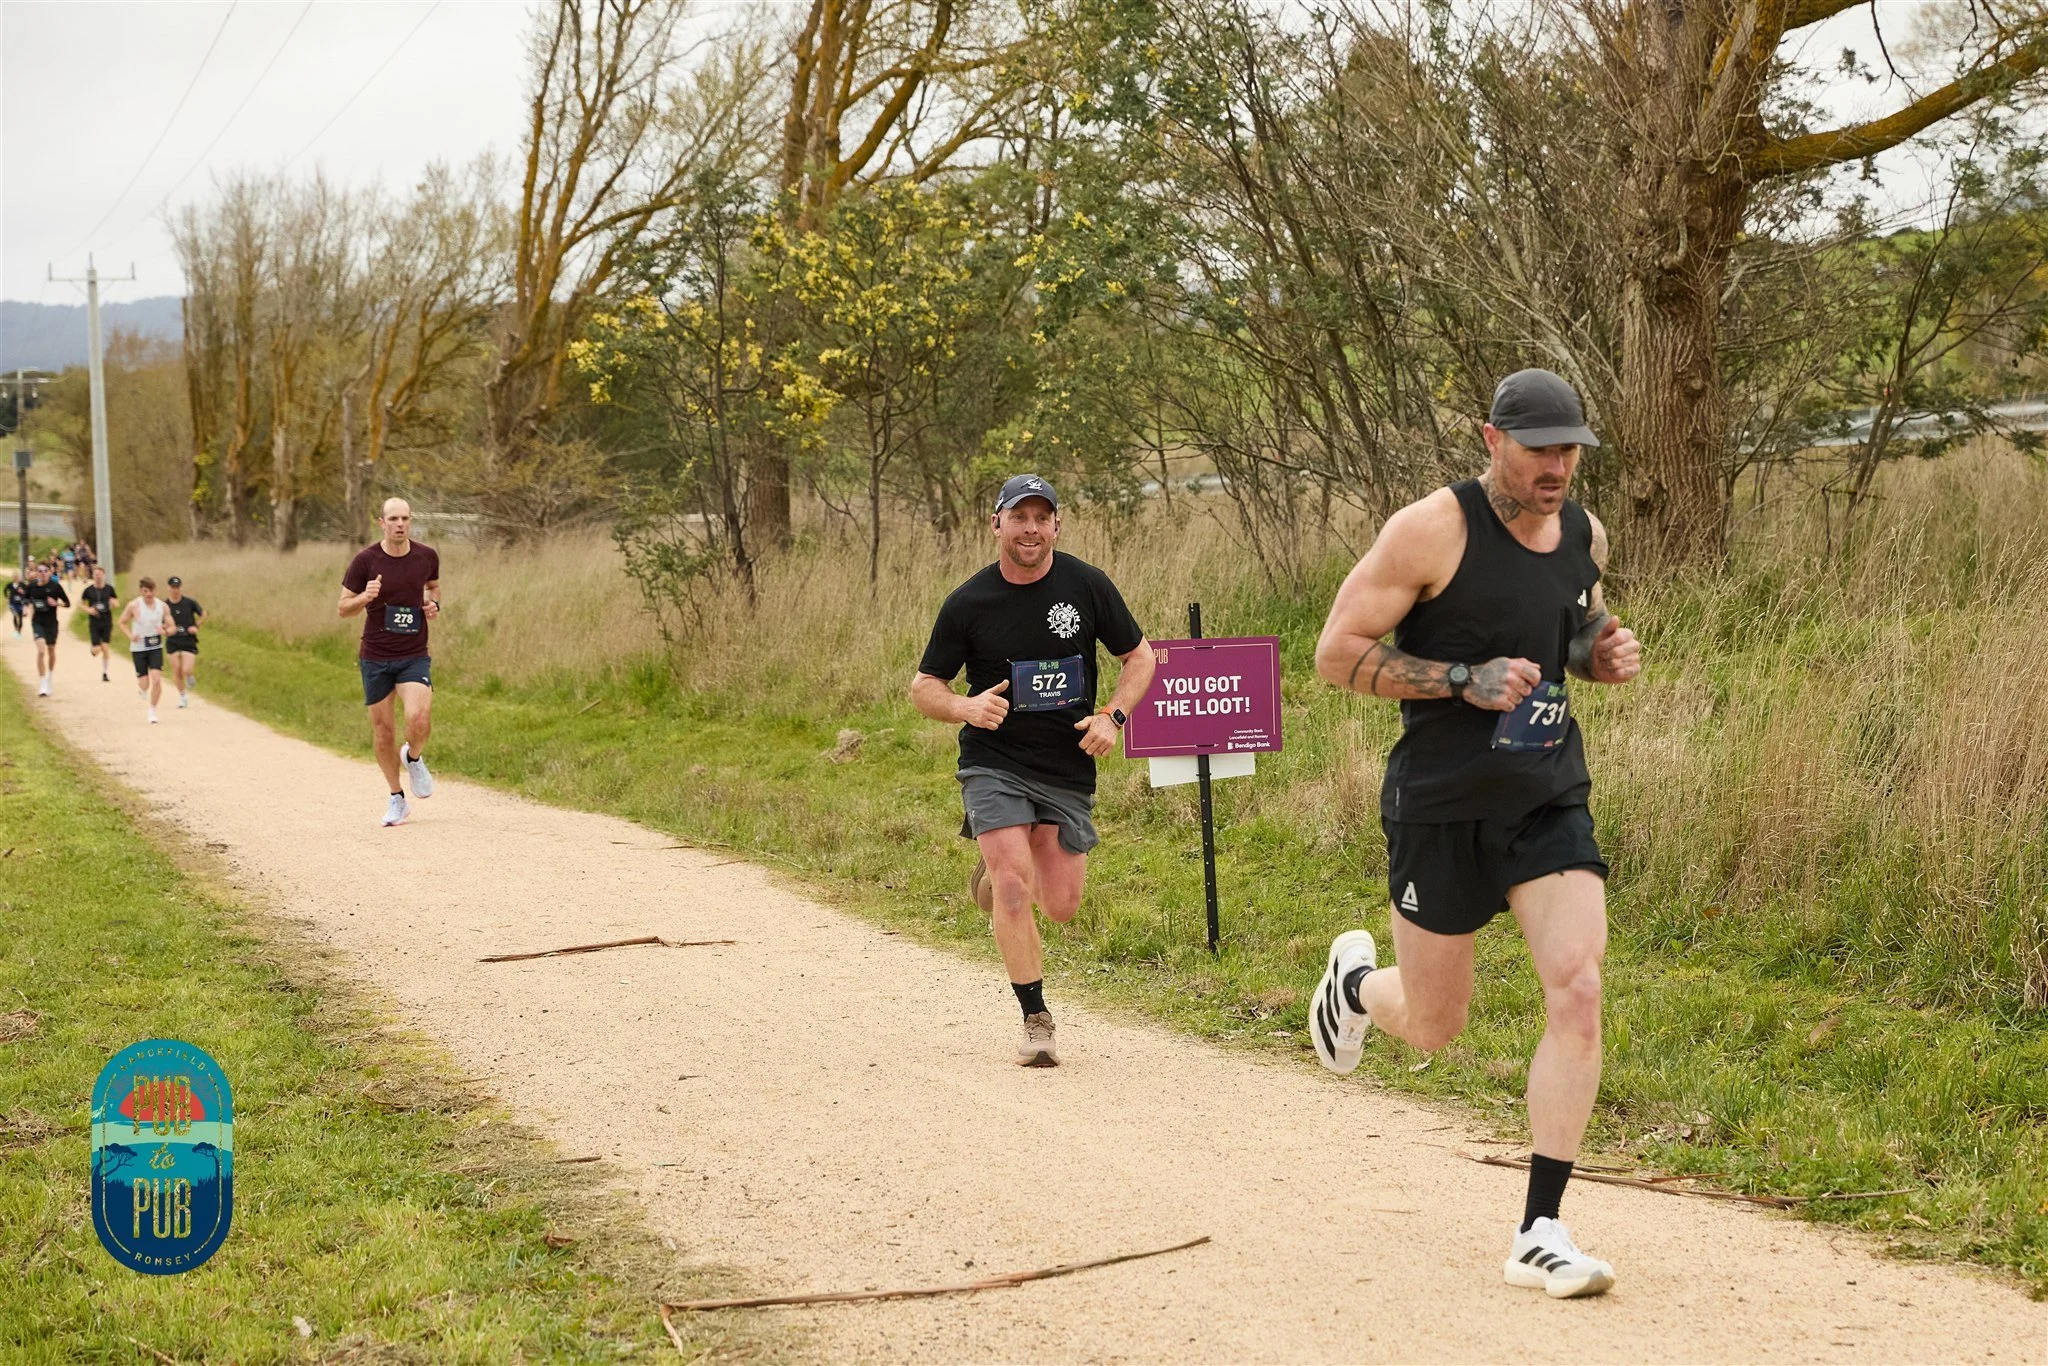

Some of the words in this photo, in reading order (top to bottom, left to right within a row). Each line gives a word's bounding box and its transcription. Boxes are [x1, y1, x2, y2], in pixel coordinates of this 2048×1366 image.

[393, 613, 414, 624] 278
[1153, 648, 1169, 664] PUB
[1032, 672, 1067, 691] 572
[1162, 677, 1200, 695] YOU
[1204, 675, 1242, 693] GOT
[1154, 699, 1191, 717] THE
[1195, 697, 1250, 716] LOOT!
[1529, 700, 1567, 726] 731
